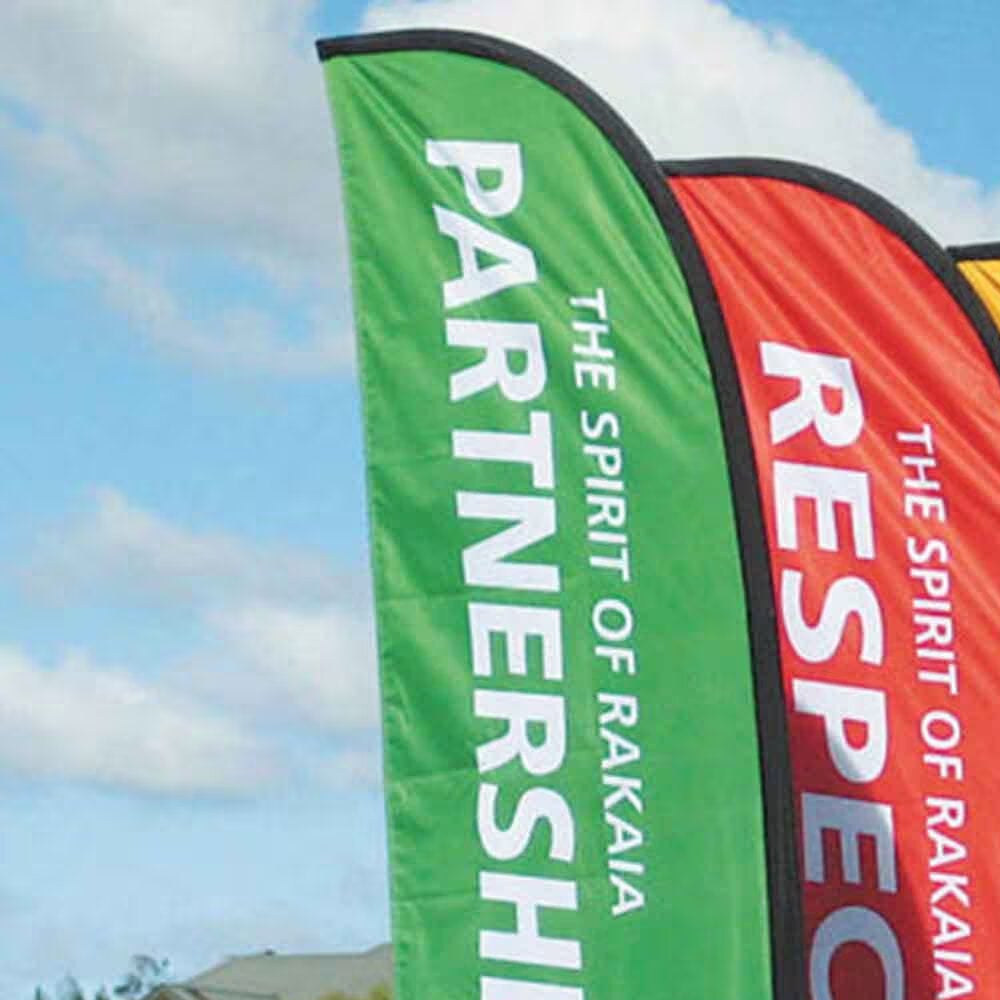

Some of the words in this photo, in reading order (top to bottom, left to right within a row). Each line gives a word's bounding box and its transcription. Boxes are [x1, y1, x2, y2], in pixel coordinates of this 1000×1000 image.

[569, 288, 616, 391] THE
[580, 411, 630, 582] SPIRIT
[897, 423, 947, 524] THE
[592, 598, 637, 675] OF
[907, 538, 958, 695] SPIRIT
[598, 692, 645, 917] RAKAIA
[921, 710, 963, 781] OF
[926, 796, 974, 1000] RAKAIA
